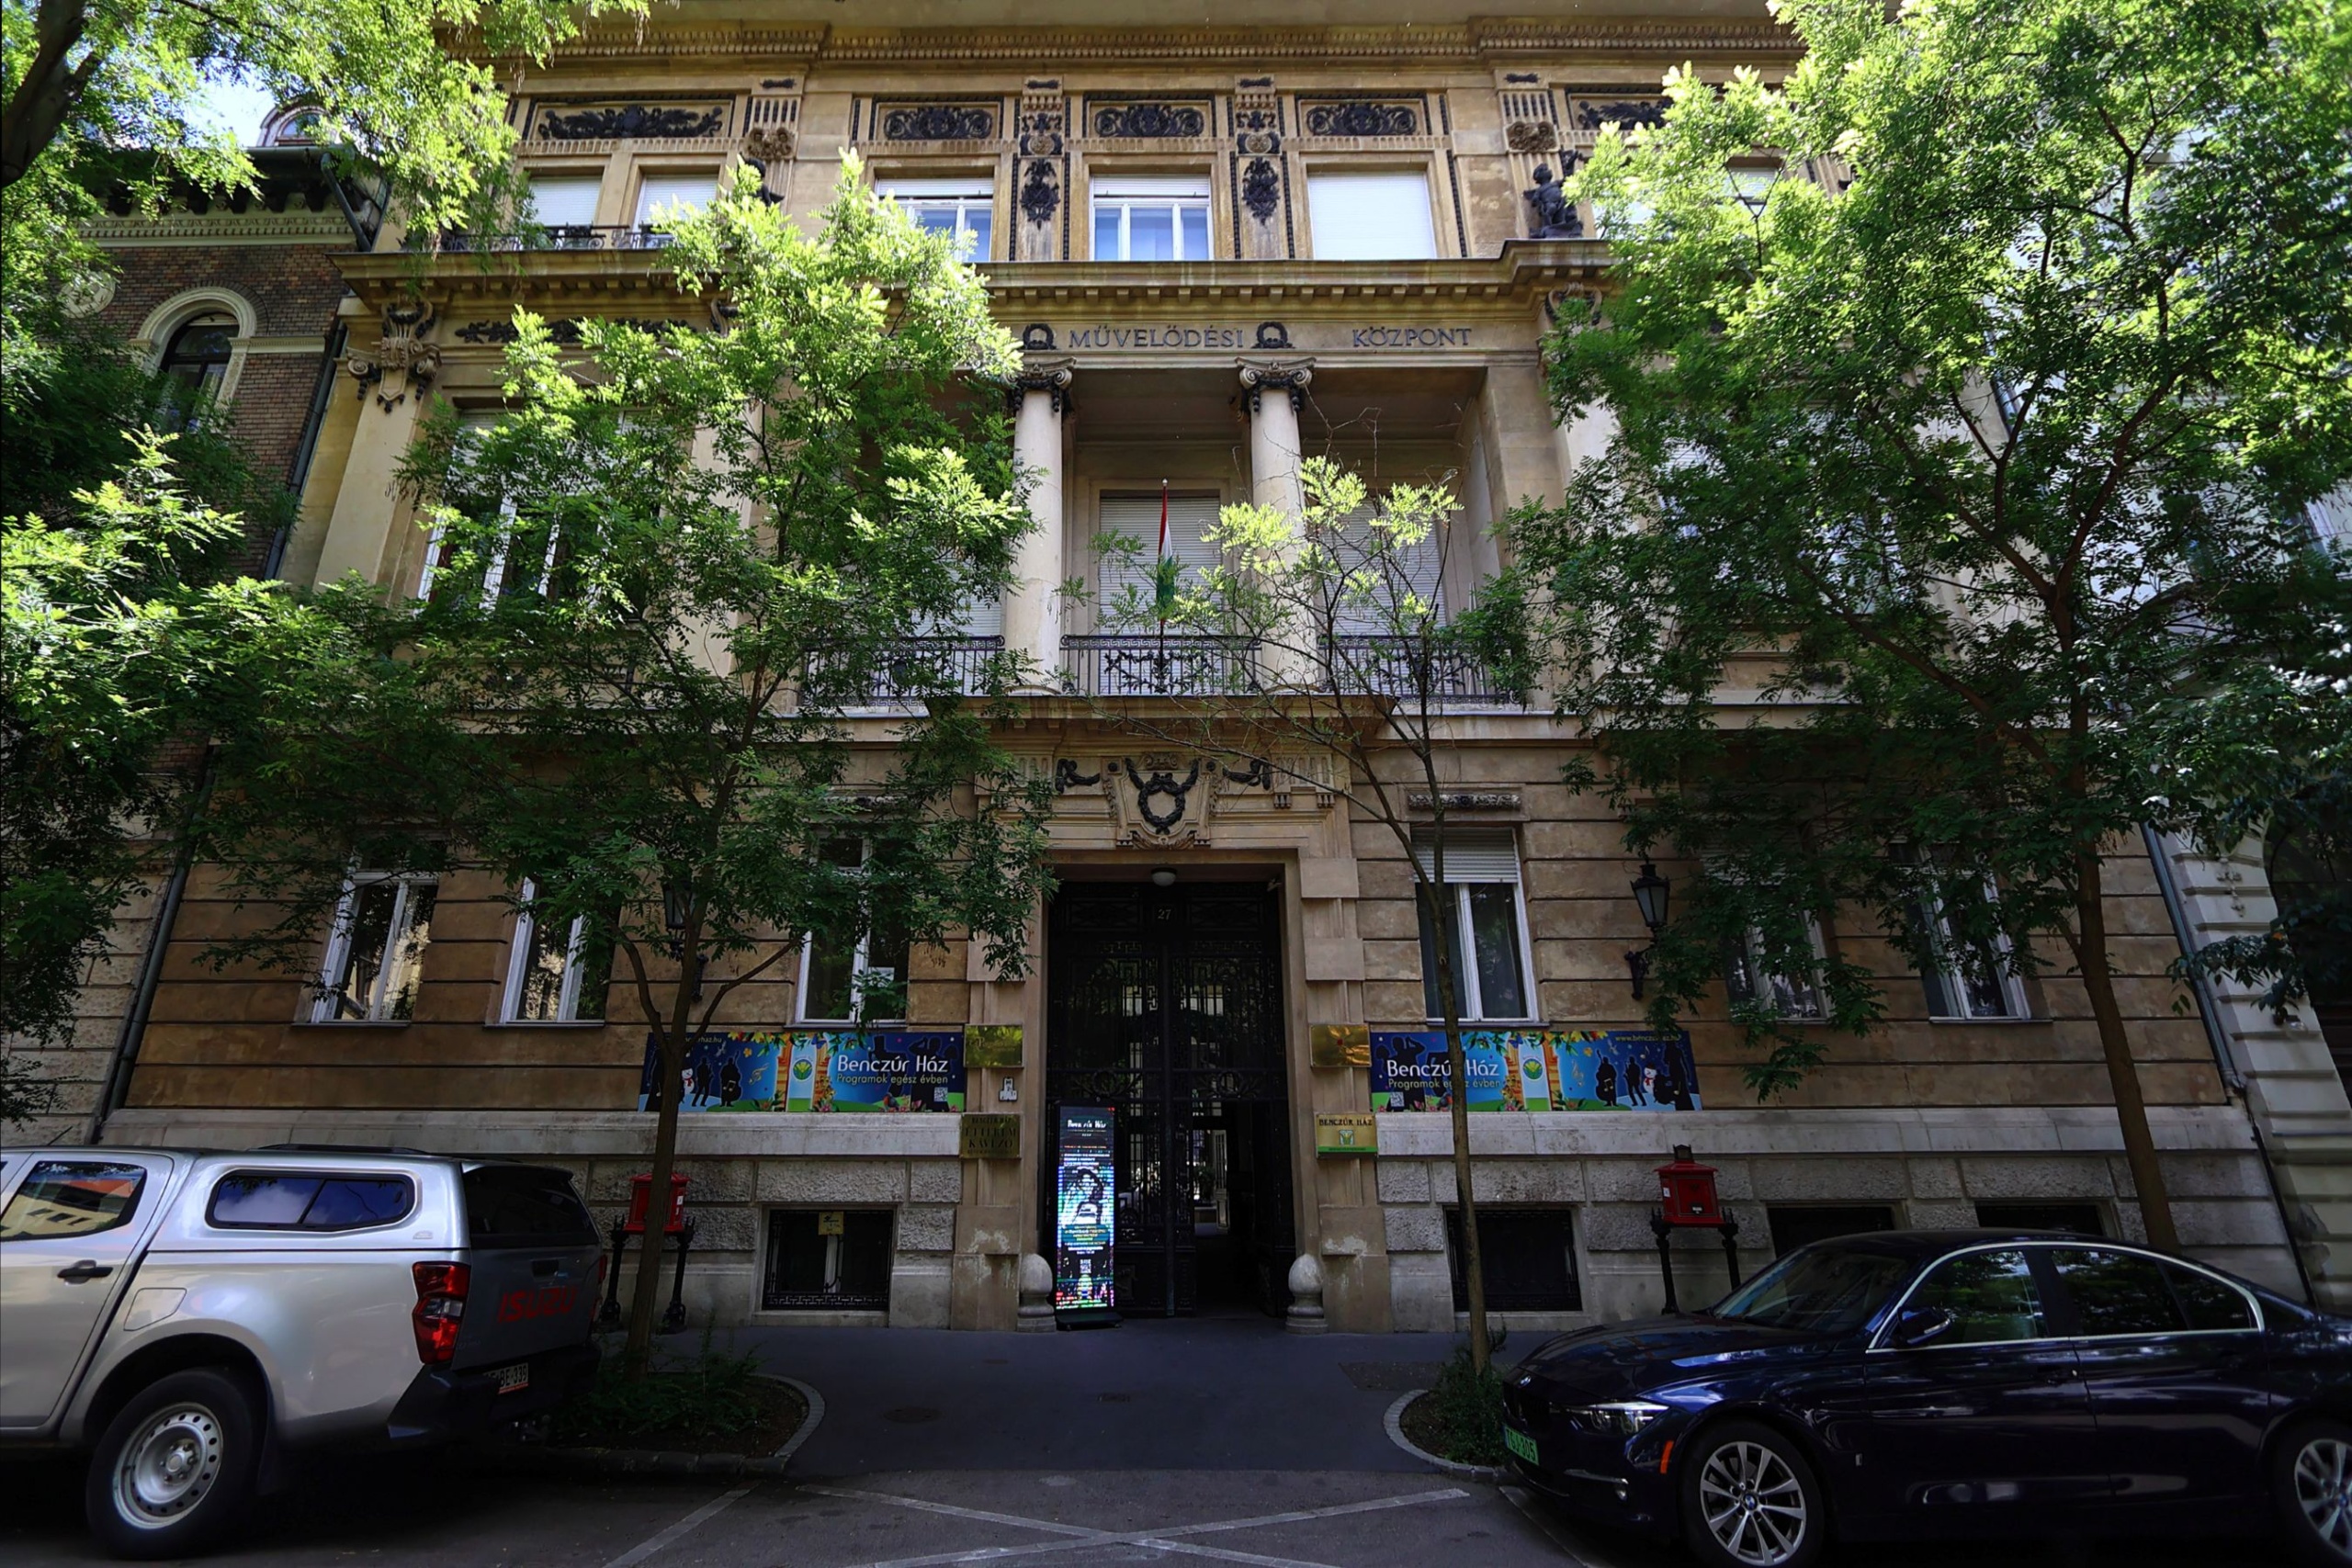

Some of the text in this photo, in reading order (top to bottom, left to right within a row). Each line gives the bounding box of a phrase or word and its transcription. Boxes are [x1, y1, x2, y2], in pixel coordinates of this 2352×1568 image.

[1351, 325, 1473, 349] KÖZPONT
[1158, 908, 1171, 920] 27
[837, 1055, 949, 1073] Benczúr Ház
[1386, 1059, 1501, 1077] Benczú Ház
[836, 1073, 949, 1086] Programok egész évben
[1388, 1078, 1441, 1090] Programok
[1473, 1078, 1502, 1089] évben
[1318, 1117, 1353, 1126] BENCZÚR
[497, 1286, 580, 1324] ISUZU
